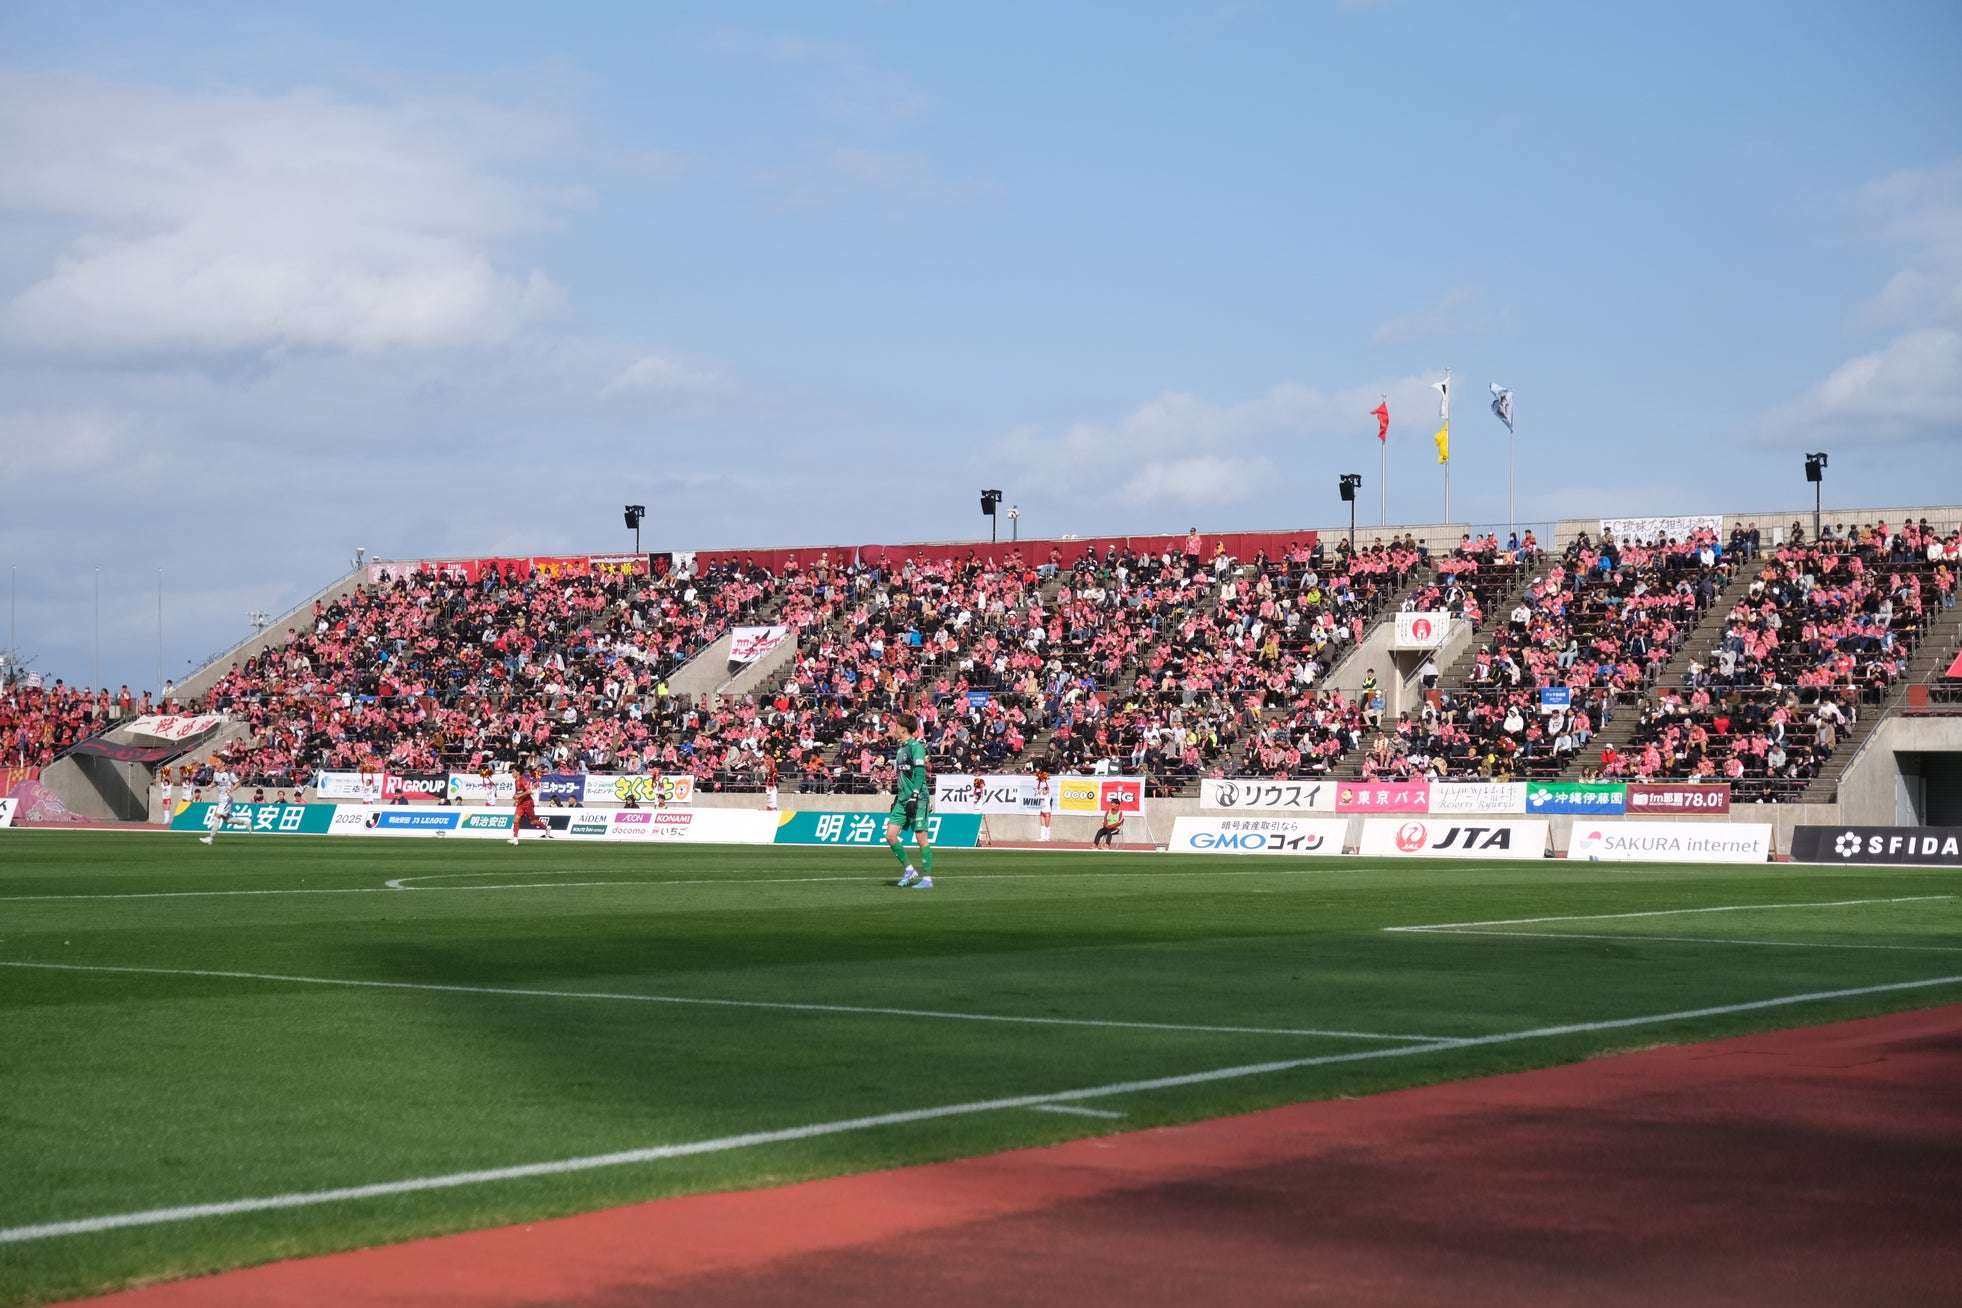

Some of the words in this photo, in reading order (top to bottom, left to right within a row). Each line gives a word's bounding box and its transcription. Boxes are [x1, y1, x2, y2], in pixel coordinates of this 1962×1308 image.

[403, 779, 446, 793] GROUP
[1245, 785, 1320, 807] リウスイ
[1357, 790, 1425, 805] 東京バス
[1684, 793, 1717, 806] 78.0
[335, 815, 363, 824] 2025
[470, 816, 508, 827] 明治安田
[656, 815, 690, 824] KONAMI
[1221, 820, 1298, 831] 暗号資産取引なら
[613, 826, 646, 834] docomo
[1190, 833, 1323, 850] GMOコイン
[1431, 828, 1511, 849] JTA
[1604, 836, 1681, 851] SAKURA
[1687, 838, 1760, 853] internet
[1868, 836, 1959, 855] SFIDA
